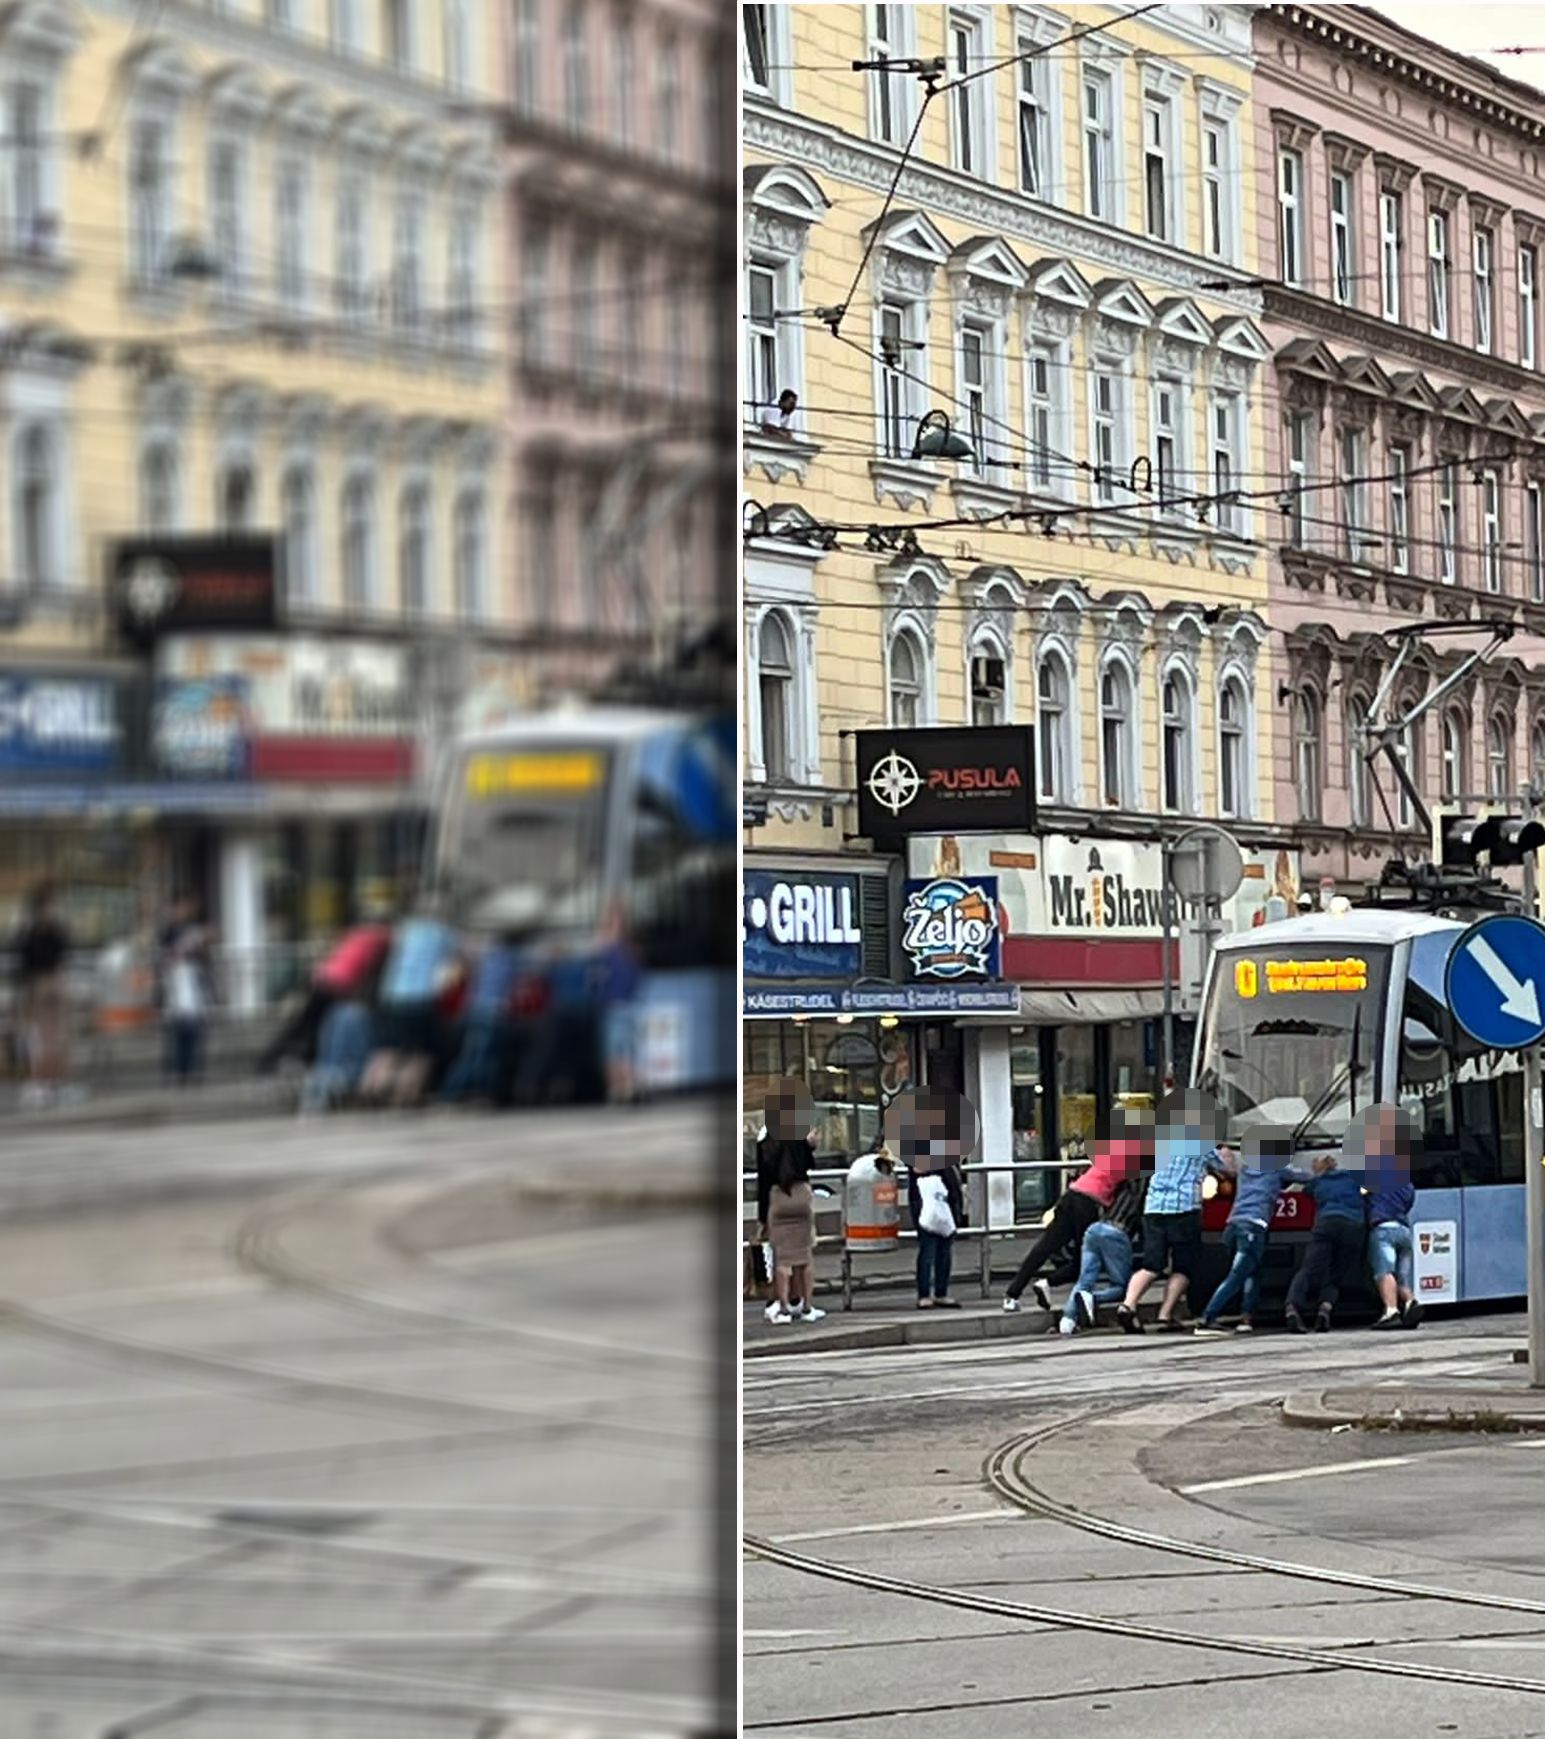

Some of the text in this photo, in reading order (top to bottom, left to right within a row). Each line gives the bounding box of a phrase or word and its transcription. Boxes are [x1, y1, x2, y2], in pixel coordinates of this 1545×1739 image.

[927, 767, 1021, 790] PUSULA
[770, 882, 861, 944] GRILL
[908, 896, 987, 955] Željo
[1050, 875, 1092, 927] Mr.
[1275, 1197, 1298, 1217] 23
